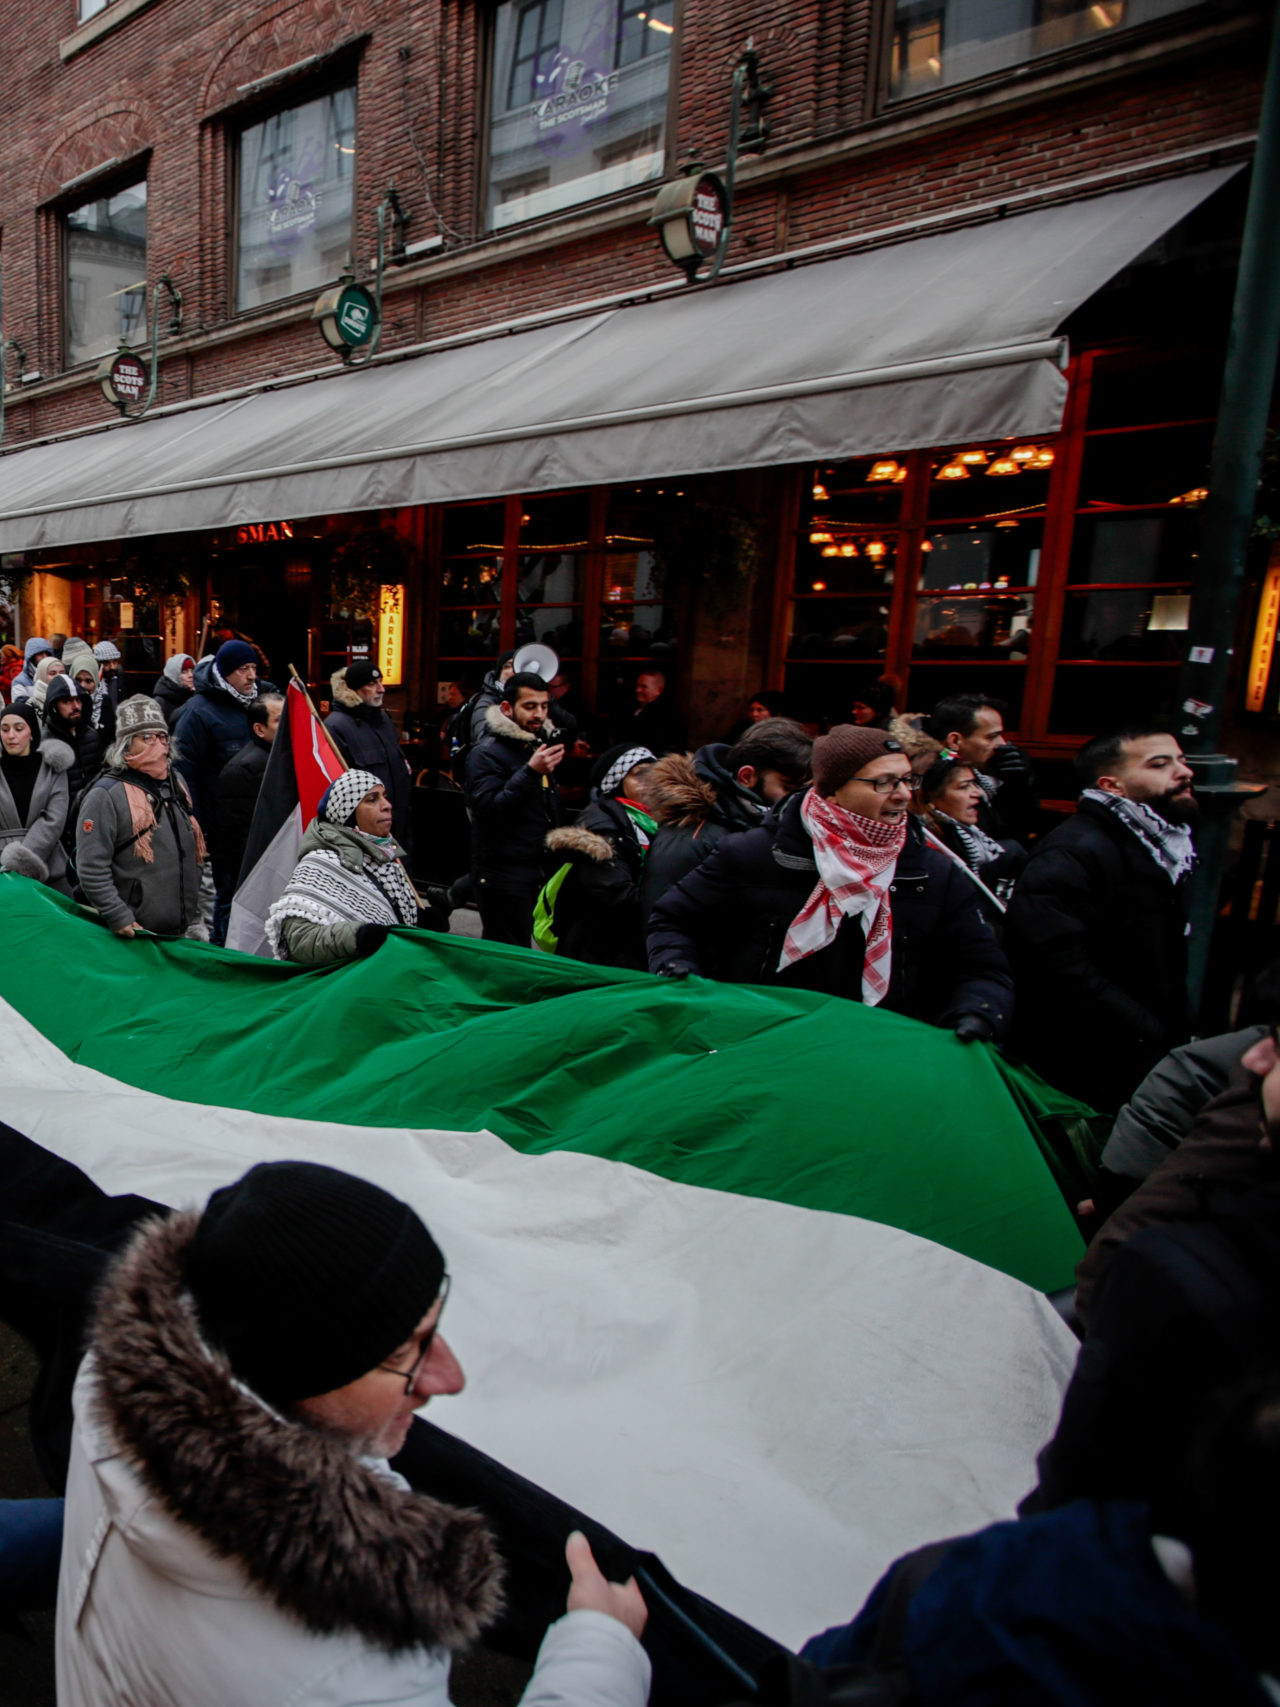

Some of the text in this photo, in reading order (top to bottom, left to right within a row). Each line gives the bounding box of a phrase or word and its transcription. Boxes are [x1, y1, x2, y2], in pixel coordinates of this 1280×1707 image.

[531, 71, 619, 118] KARAOKE
[697, 193, 718, 211] THE
[692, 208, 722, 232] SCOTS
[695, 225, 717, 248] MAN
[113, 373, 144, 386] SCOTS
[119, 364, 138, 376] THE
[117, 383, 139, 400] MAN
[386, 604, 395, 678] KARAOKE
